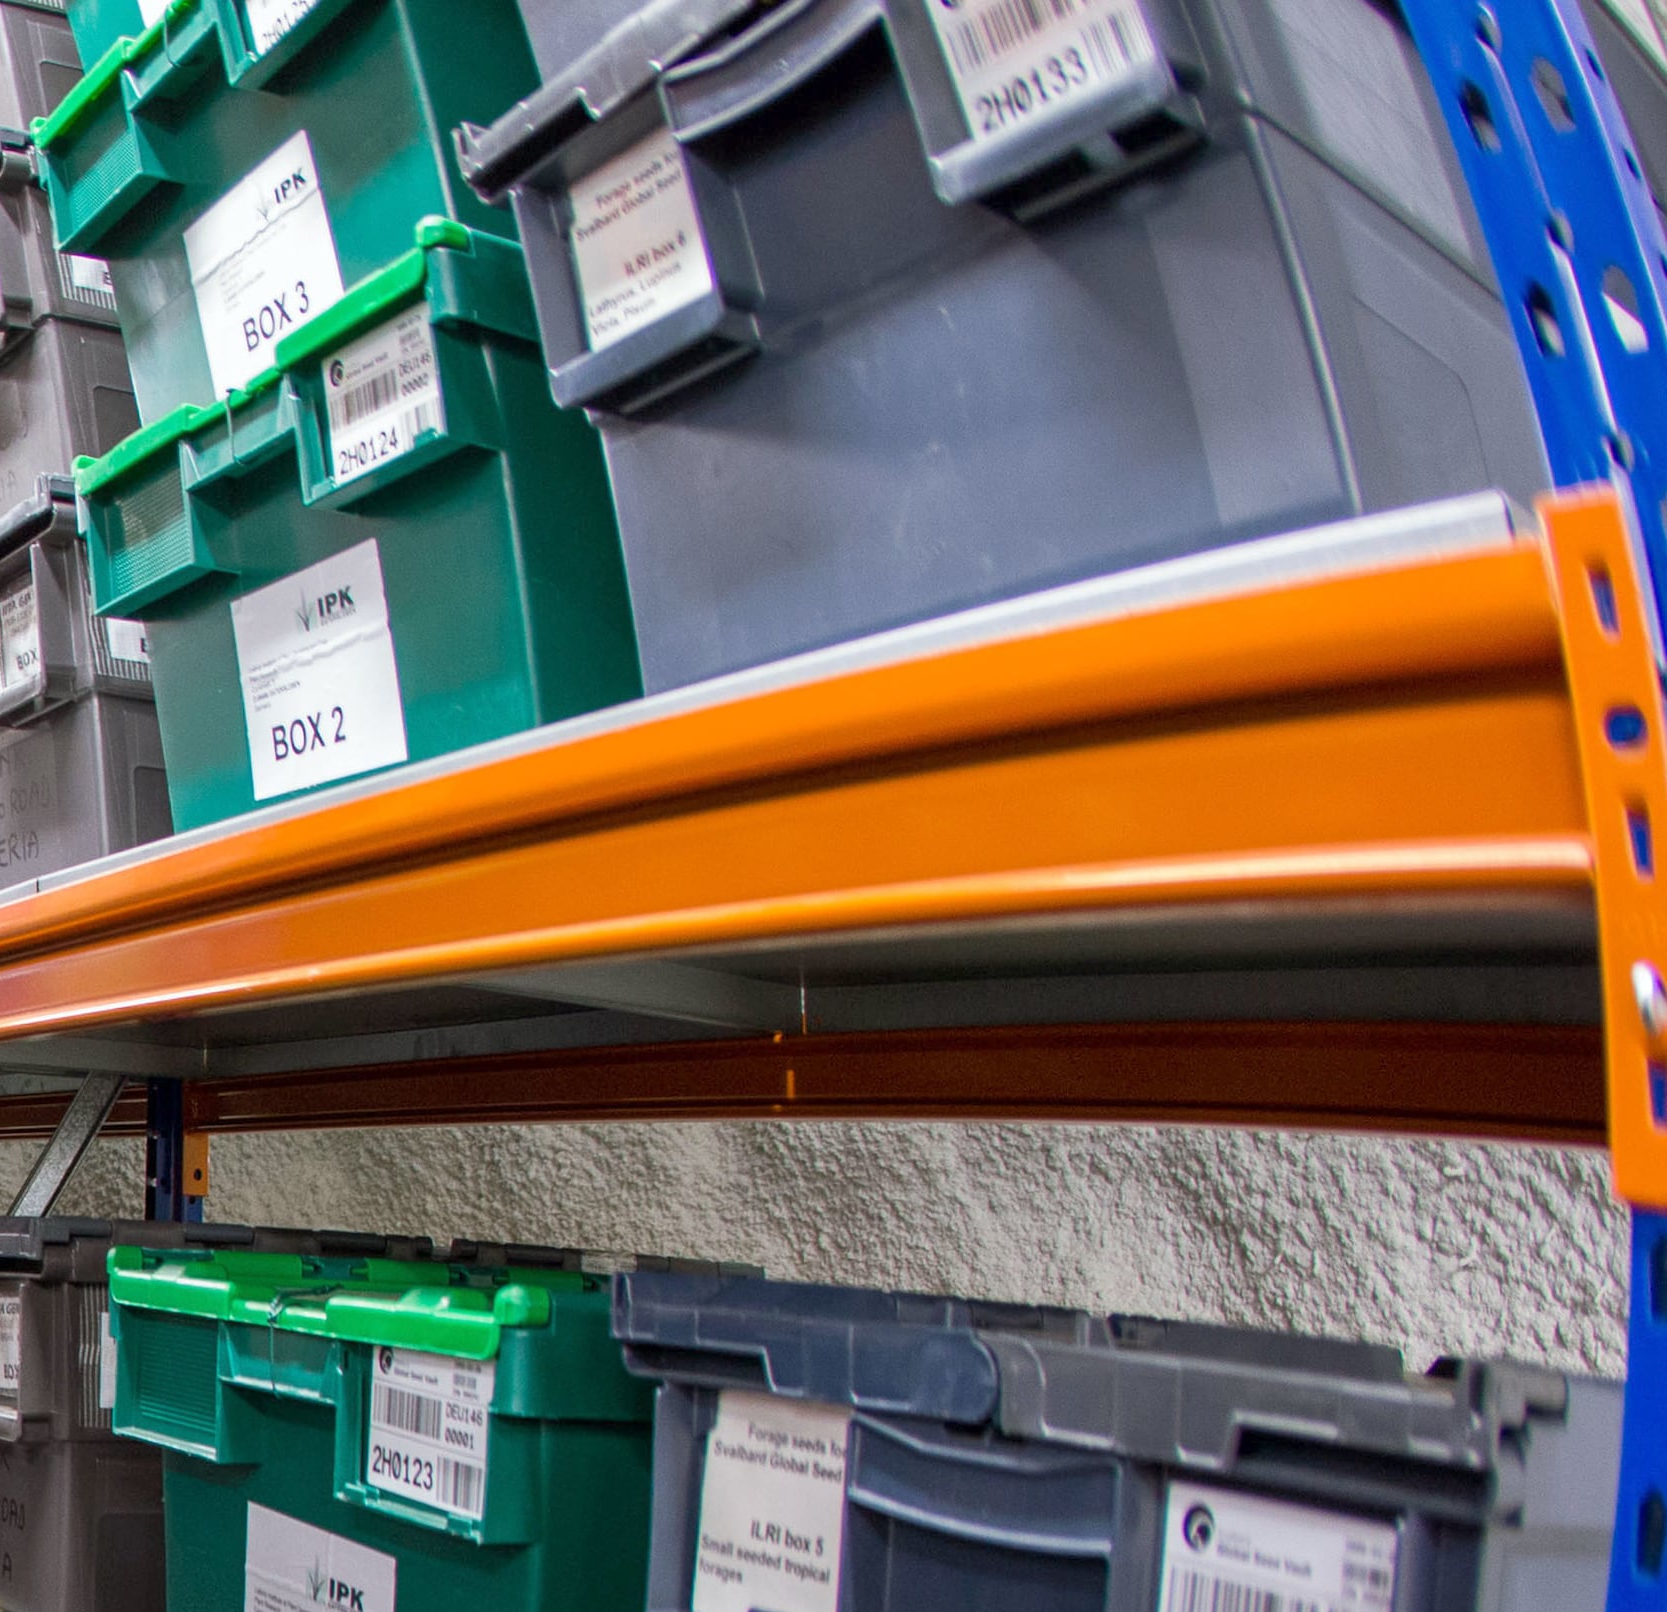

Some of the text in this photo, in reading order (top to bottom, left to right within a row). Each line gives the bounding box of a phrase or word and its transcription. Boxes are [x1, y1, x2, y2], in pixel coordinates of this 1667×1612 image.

[974, 46, 1089, 134] 2H0133
[273, 166, 308, 206] IPK
[624, 251, 651, 277] ILRI
[652, 241, 676, 263] box
[242, 280, 309, 351] BOX 3
[340, 426, 398, 475] 2H0124
[317, 585, 354, 617] IPK
[16, 648, 38, 670] BOX
[272, 706, 346, 761] BOX 2
[445, 1401, 483, 1427] DEU146
[445, 1427, 474, 1450] 00001
[748, 1421, 827, 1455] Forage seeds
[372, 1444, 434, 1491] 2H0123
[713, 1440, 843, 1484] Svalbard Global Seed
[750, 1519, 824, 1557] ILRI box 5
[699, 1557, 743, 1584] forages
[701, 1535, 830, 1585] Small seeded tropical
[329, 1578, 365, 1612] IPK
